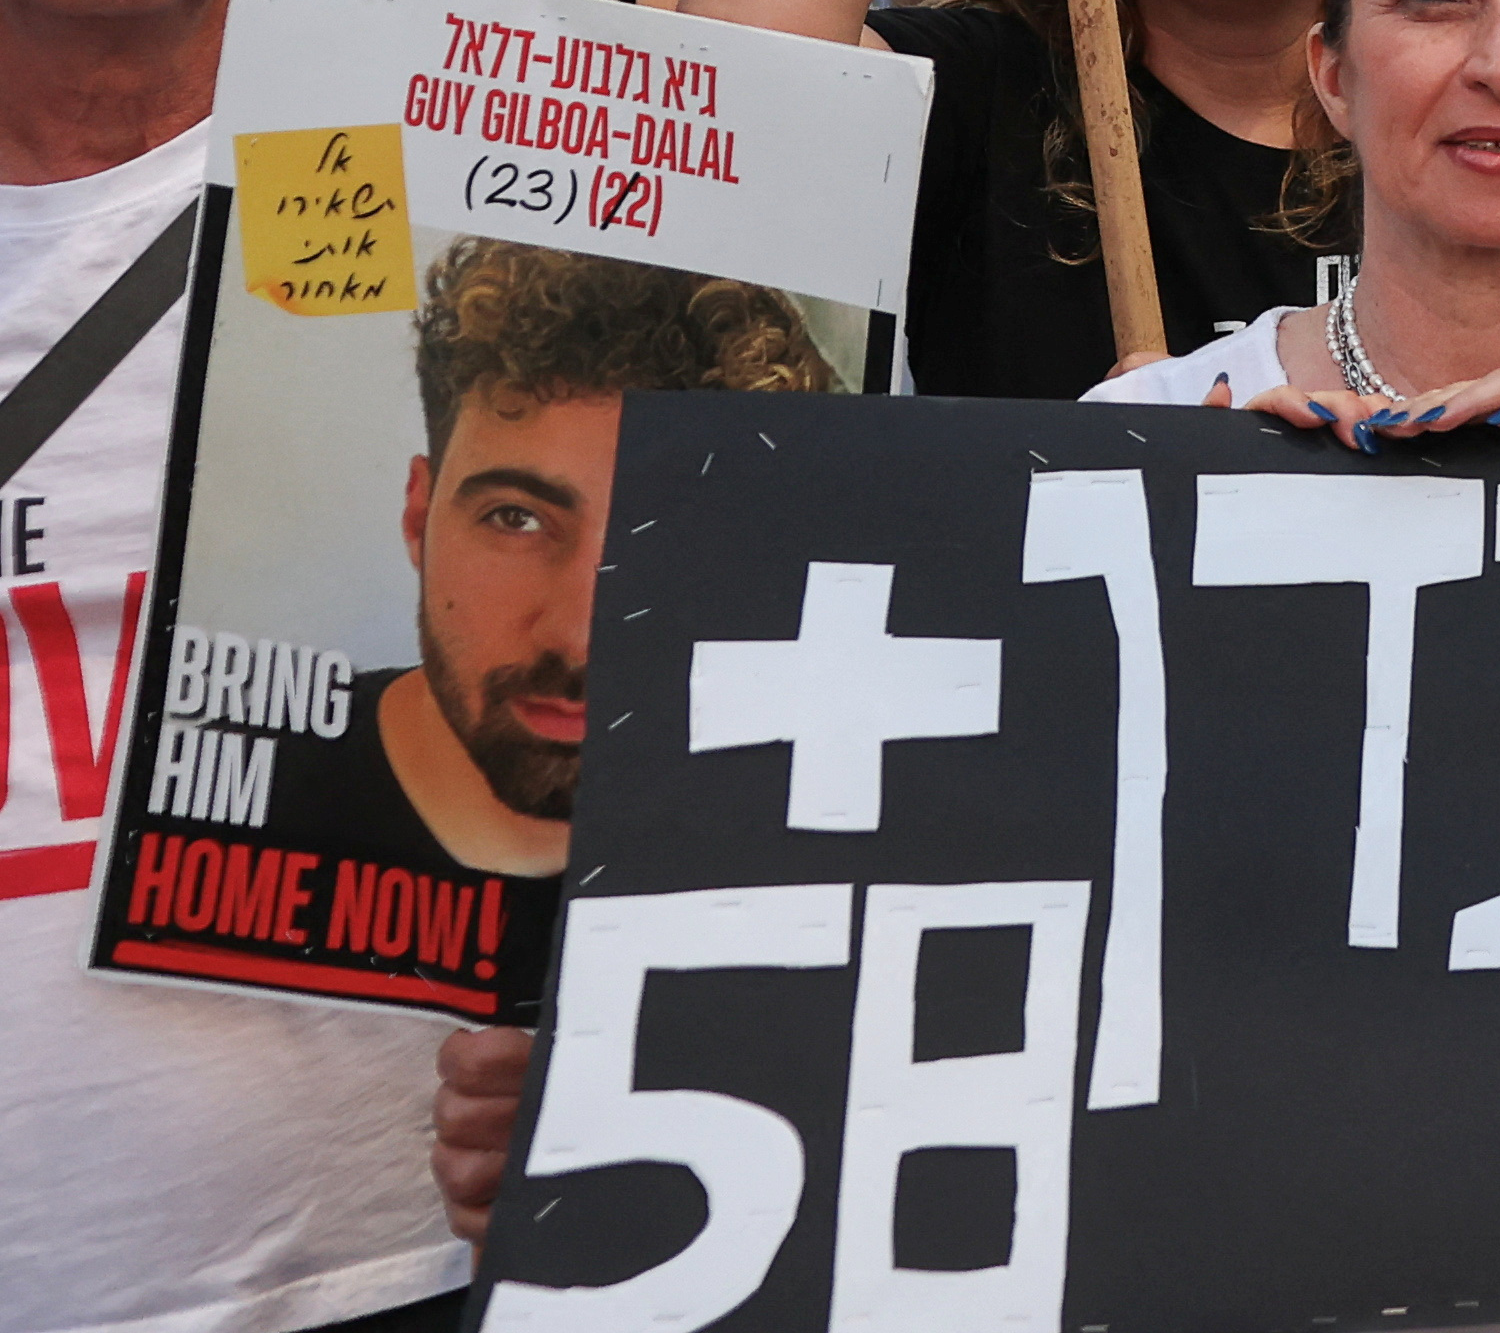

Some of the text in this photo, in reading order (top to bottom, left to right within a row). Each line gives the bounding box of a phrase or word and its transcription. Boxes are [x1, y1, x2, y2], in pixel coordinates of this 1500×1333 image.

[443, 12, 717, 118] גיא גלבוע-דלאל
[316, 132, 353, 175] אל
[404, 73, 740, 184] GUY GILBOA-DALAL
[465, 155, 578, 225] (23)
[280, 272, 387, 303] מאחור
[165, 625, 353, 738] BRING
[147, 727, 278, 828] HIM
[127, 830, 508, 980] HOME NOW!
[481, 879, 1093, 1333] 58
